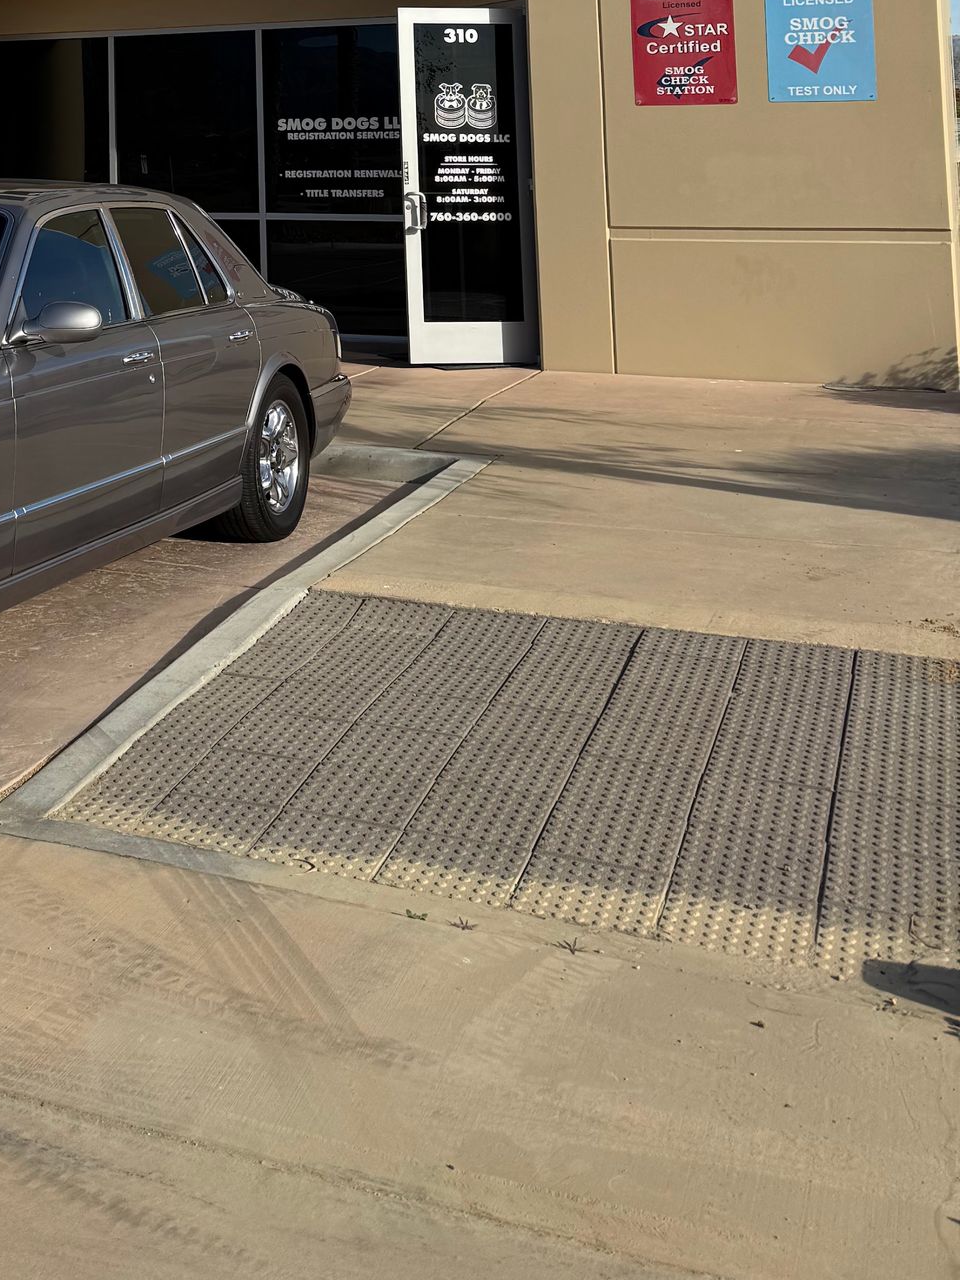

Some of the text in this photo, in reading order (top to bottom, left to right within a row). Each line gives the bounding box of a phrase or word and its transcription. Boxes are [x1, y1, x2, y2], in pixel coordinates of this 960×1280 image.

[662, 0, 701, 9] Licensed
[790, 16, 849, 31] SMOG
[684, 23, 728, 36] STAR
[443, 28, 478, 43] 310
[784, 30, 856, 45] CHECK
[646, 40, 721, 54] Certified
[665, 66, 704, 75] SMOG
[661, 75, 709, 85] CHECK
[657, 85, 715, 95] STATION
[787, 85, 857, 96] TEST ONLY
[277, 117, 400, 131] SMOG DOGS LL
[287, 131, 400, 140] REGISTRATION SERVICES
[423, 133, 511, 143] SMOG DOGS LLC
[285, 170, 352, 178] REGISTRATION
[430, 212, 512, 222] 760-360-6000
